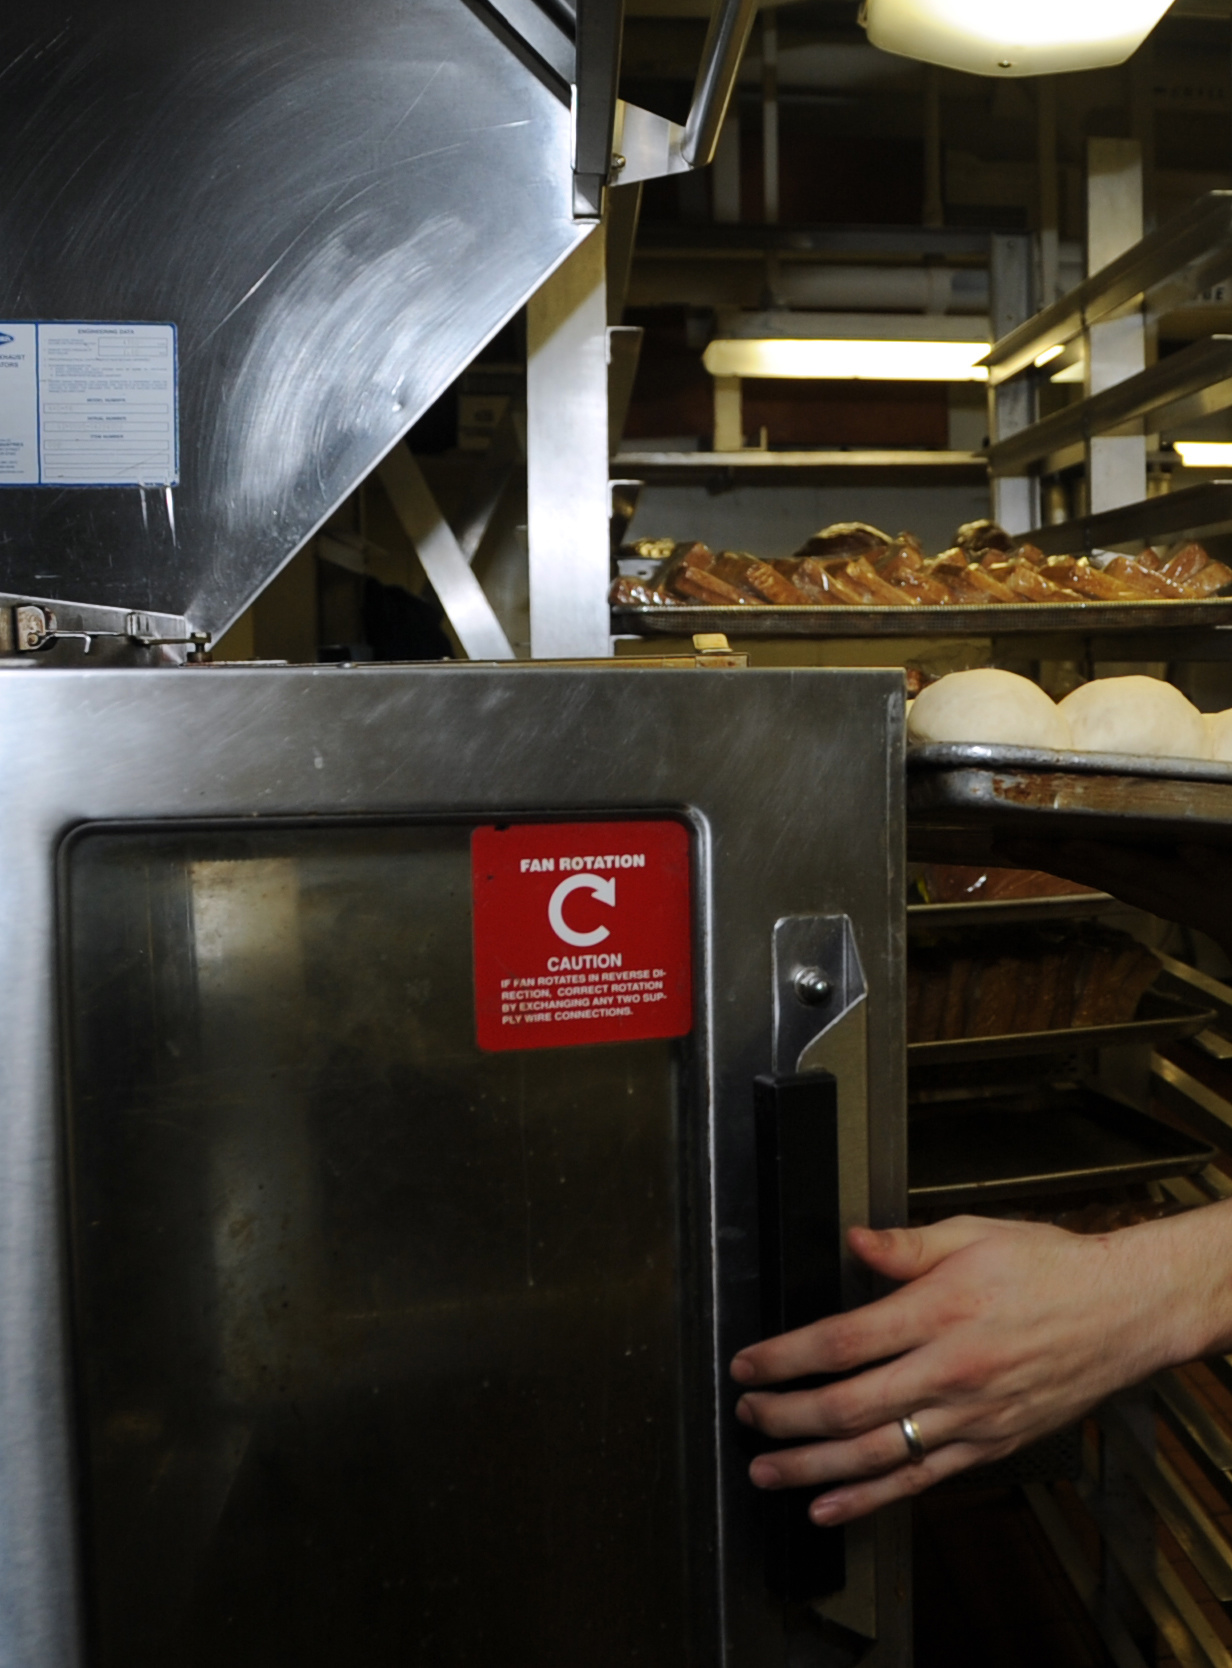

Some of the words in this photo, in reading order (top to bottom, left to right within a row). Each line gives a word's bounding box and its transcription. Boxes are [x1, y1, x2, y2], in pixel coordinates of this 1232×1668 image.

[520, 857, 555, 873] FAN
[559, 853, 645, 871] ROTATION
[547, 953, 623, 972] CAUTION
[501, 979, 511, 988] IF
[513, 977, 536, 988] FAN
[537, 974, 586, 986] ROTATES
[588, 973, 600, 983] IN
[601, 969, 650, 981] REVERSE
[652, 968, 667, 979] DI-
[557, 984, 609, 997] CORRECT
[611, 980, 664, 992] ROTATION
[501, 1003, 516, 1013] BY
[519, 998, 590, 1011] EXCHANGING
[592, 995, 614, 1006] ANY
[616, 993, 641, 1004] TWO
[643, 991, 667, 1003] SUP-
[502, 1014, 522, 1025] PLY
[524, 1012, 552, 1023] WIRE
[554, 1006, 633, 1021] CONNECTIONS.
